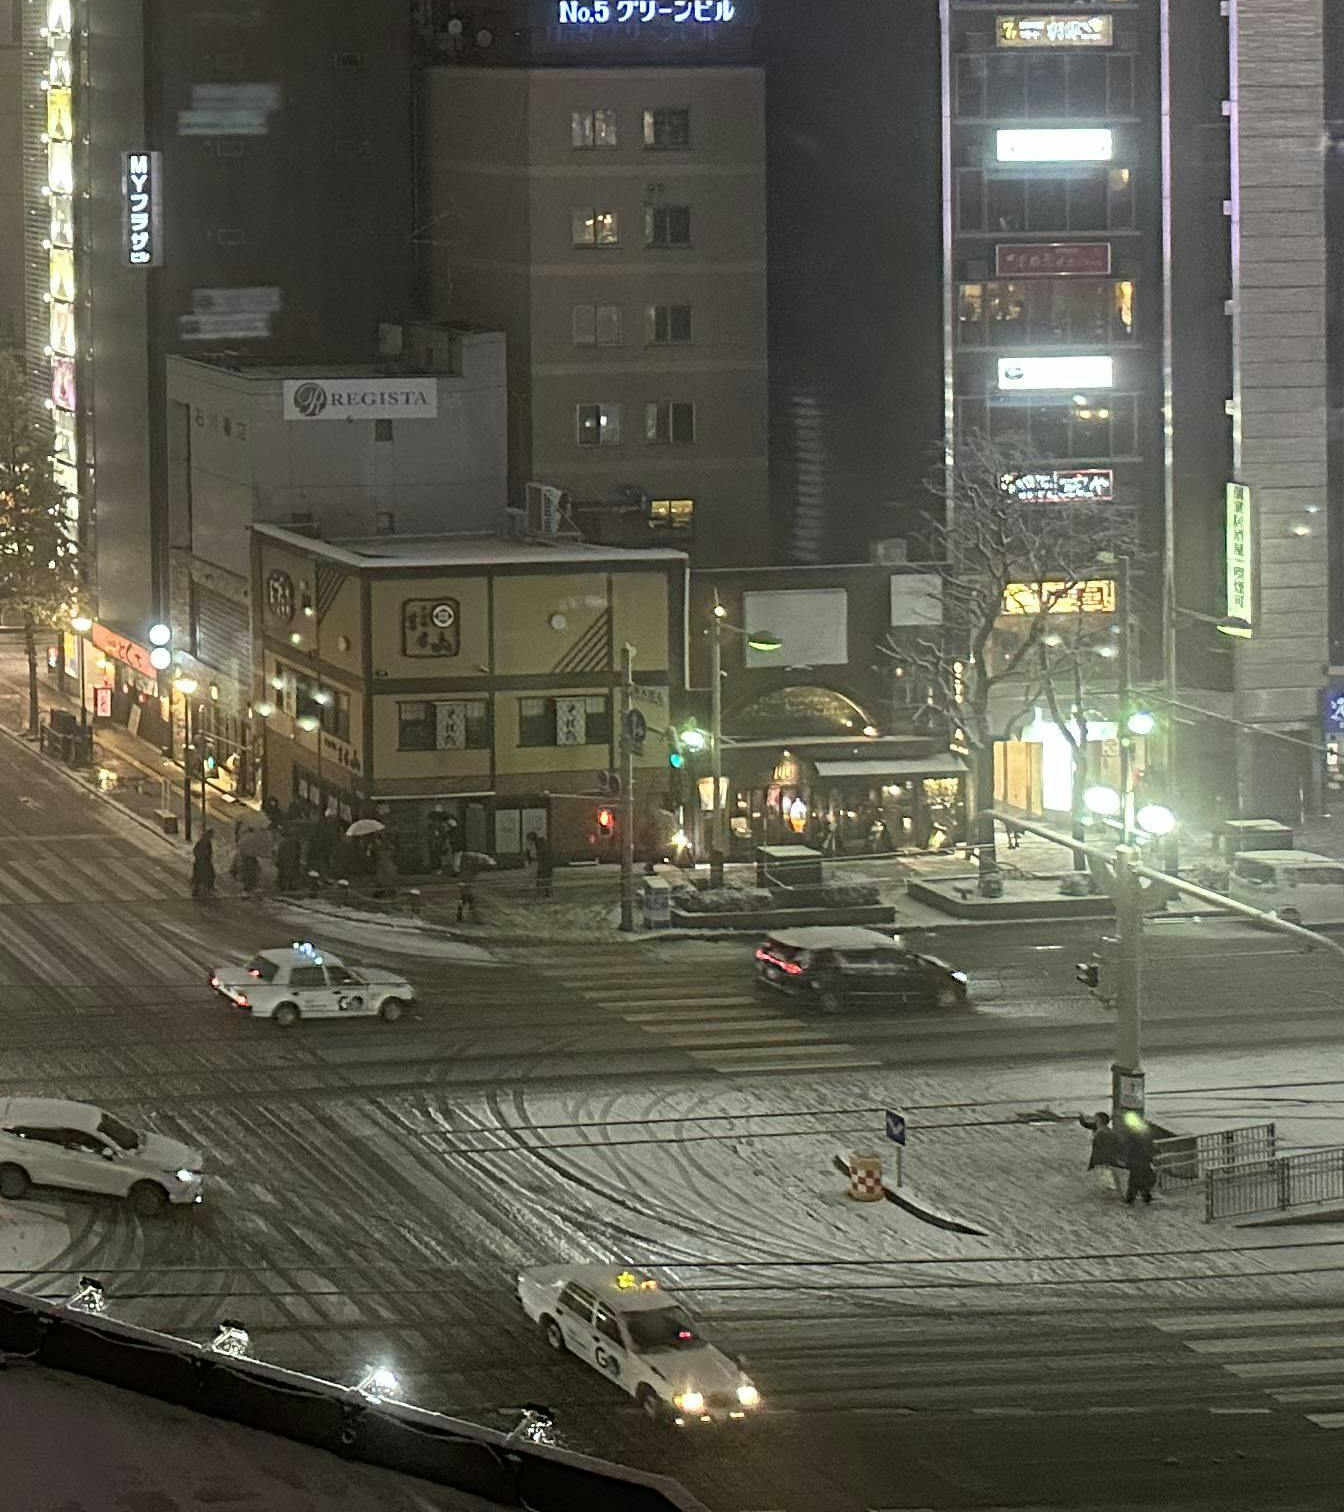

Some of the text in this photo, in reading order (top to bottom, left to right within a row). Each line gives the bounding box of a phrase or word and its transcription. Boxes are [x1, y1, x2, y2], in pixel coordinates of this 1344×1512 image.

[559, 0, 736, 23] No.5 グリーンビル
[331, 391, 429, 408] REGISTA
